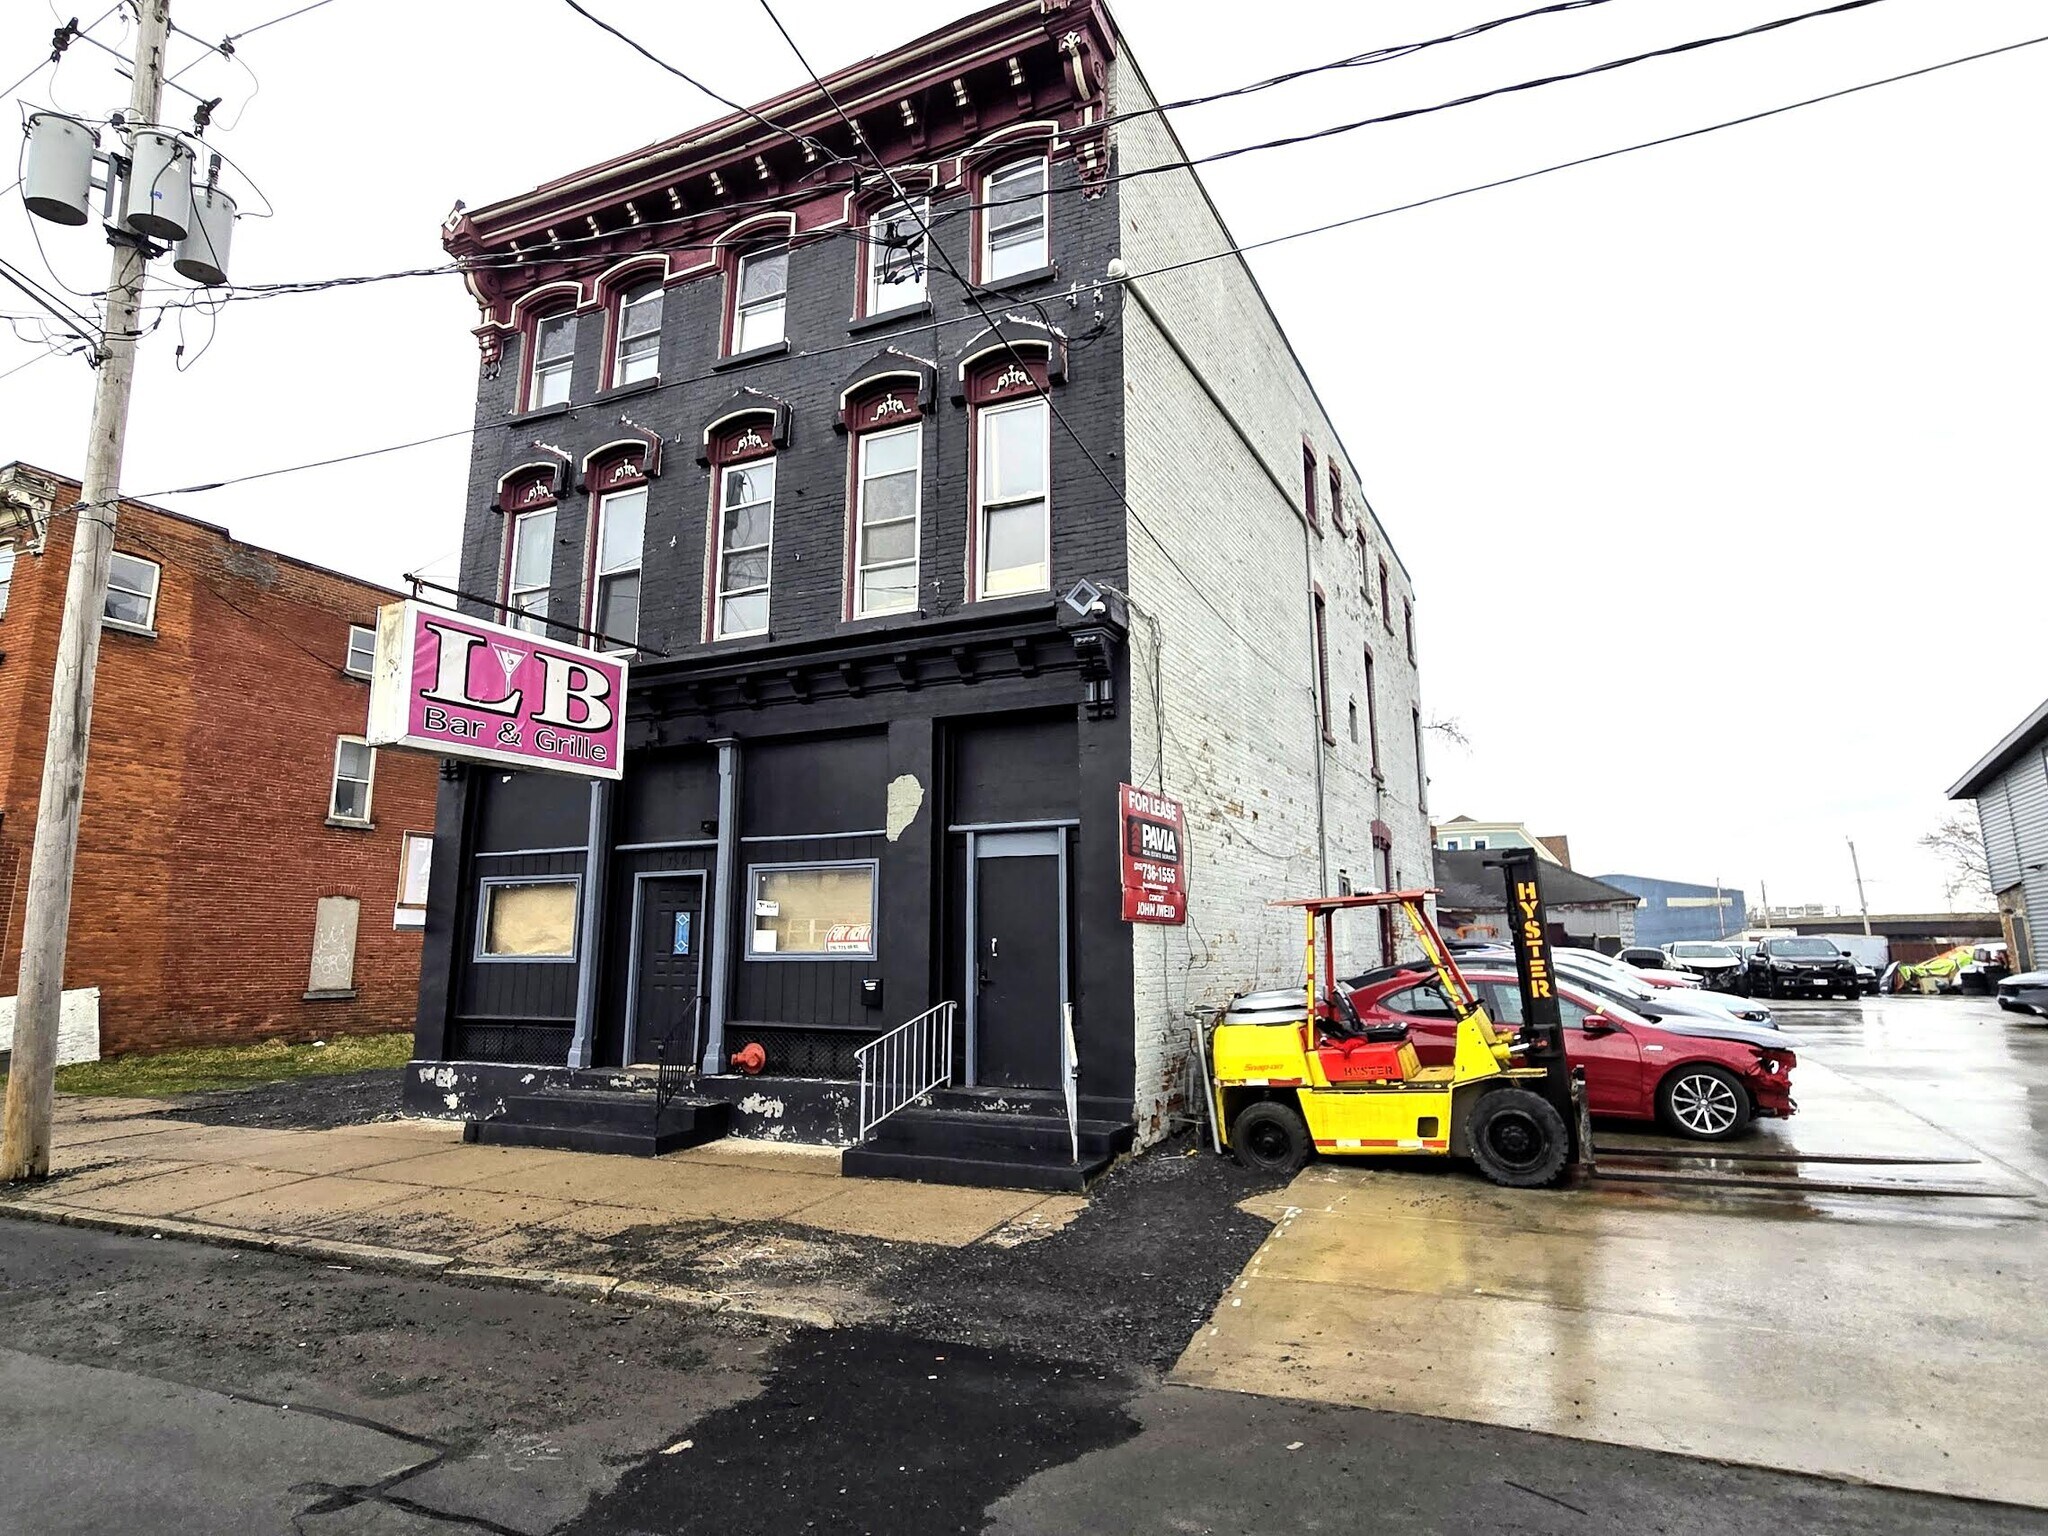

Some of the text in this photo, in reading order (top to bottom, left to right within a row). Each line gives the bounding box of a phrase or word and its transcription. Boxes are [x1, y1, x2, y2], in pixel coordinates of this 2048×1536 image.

[424, 705, 608, 761] Bar & Grille
[1128, 790, 1177, 822] FOR LEASE
[1142, 823, 1177, 854] PAVIA
[1142, 863, 1176, 884] 736-1555
[1136, 902, 1155, 916] JOHN
[828, 925, 872, 941] FOR RENT
[1517, 882, 1552, 998] HYSTER
[1243, 1063, 1284, 1072] Snap-on
[1344, 1066, 1393, 1076] HYSTER
